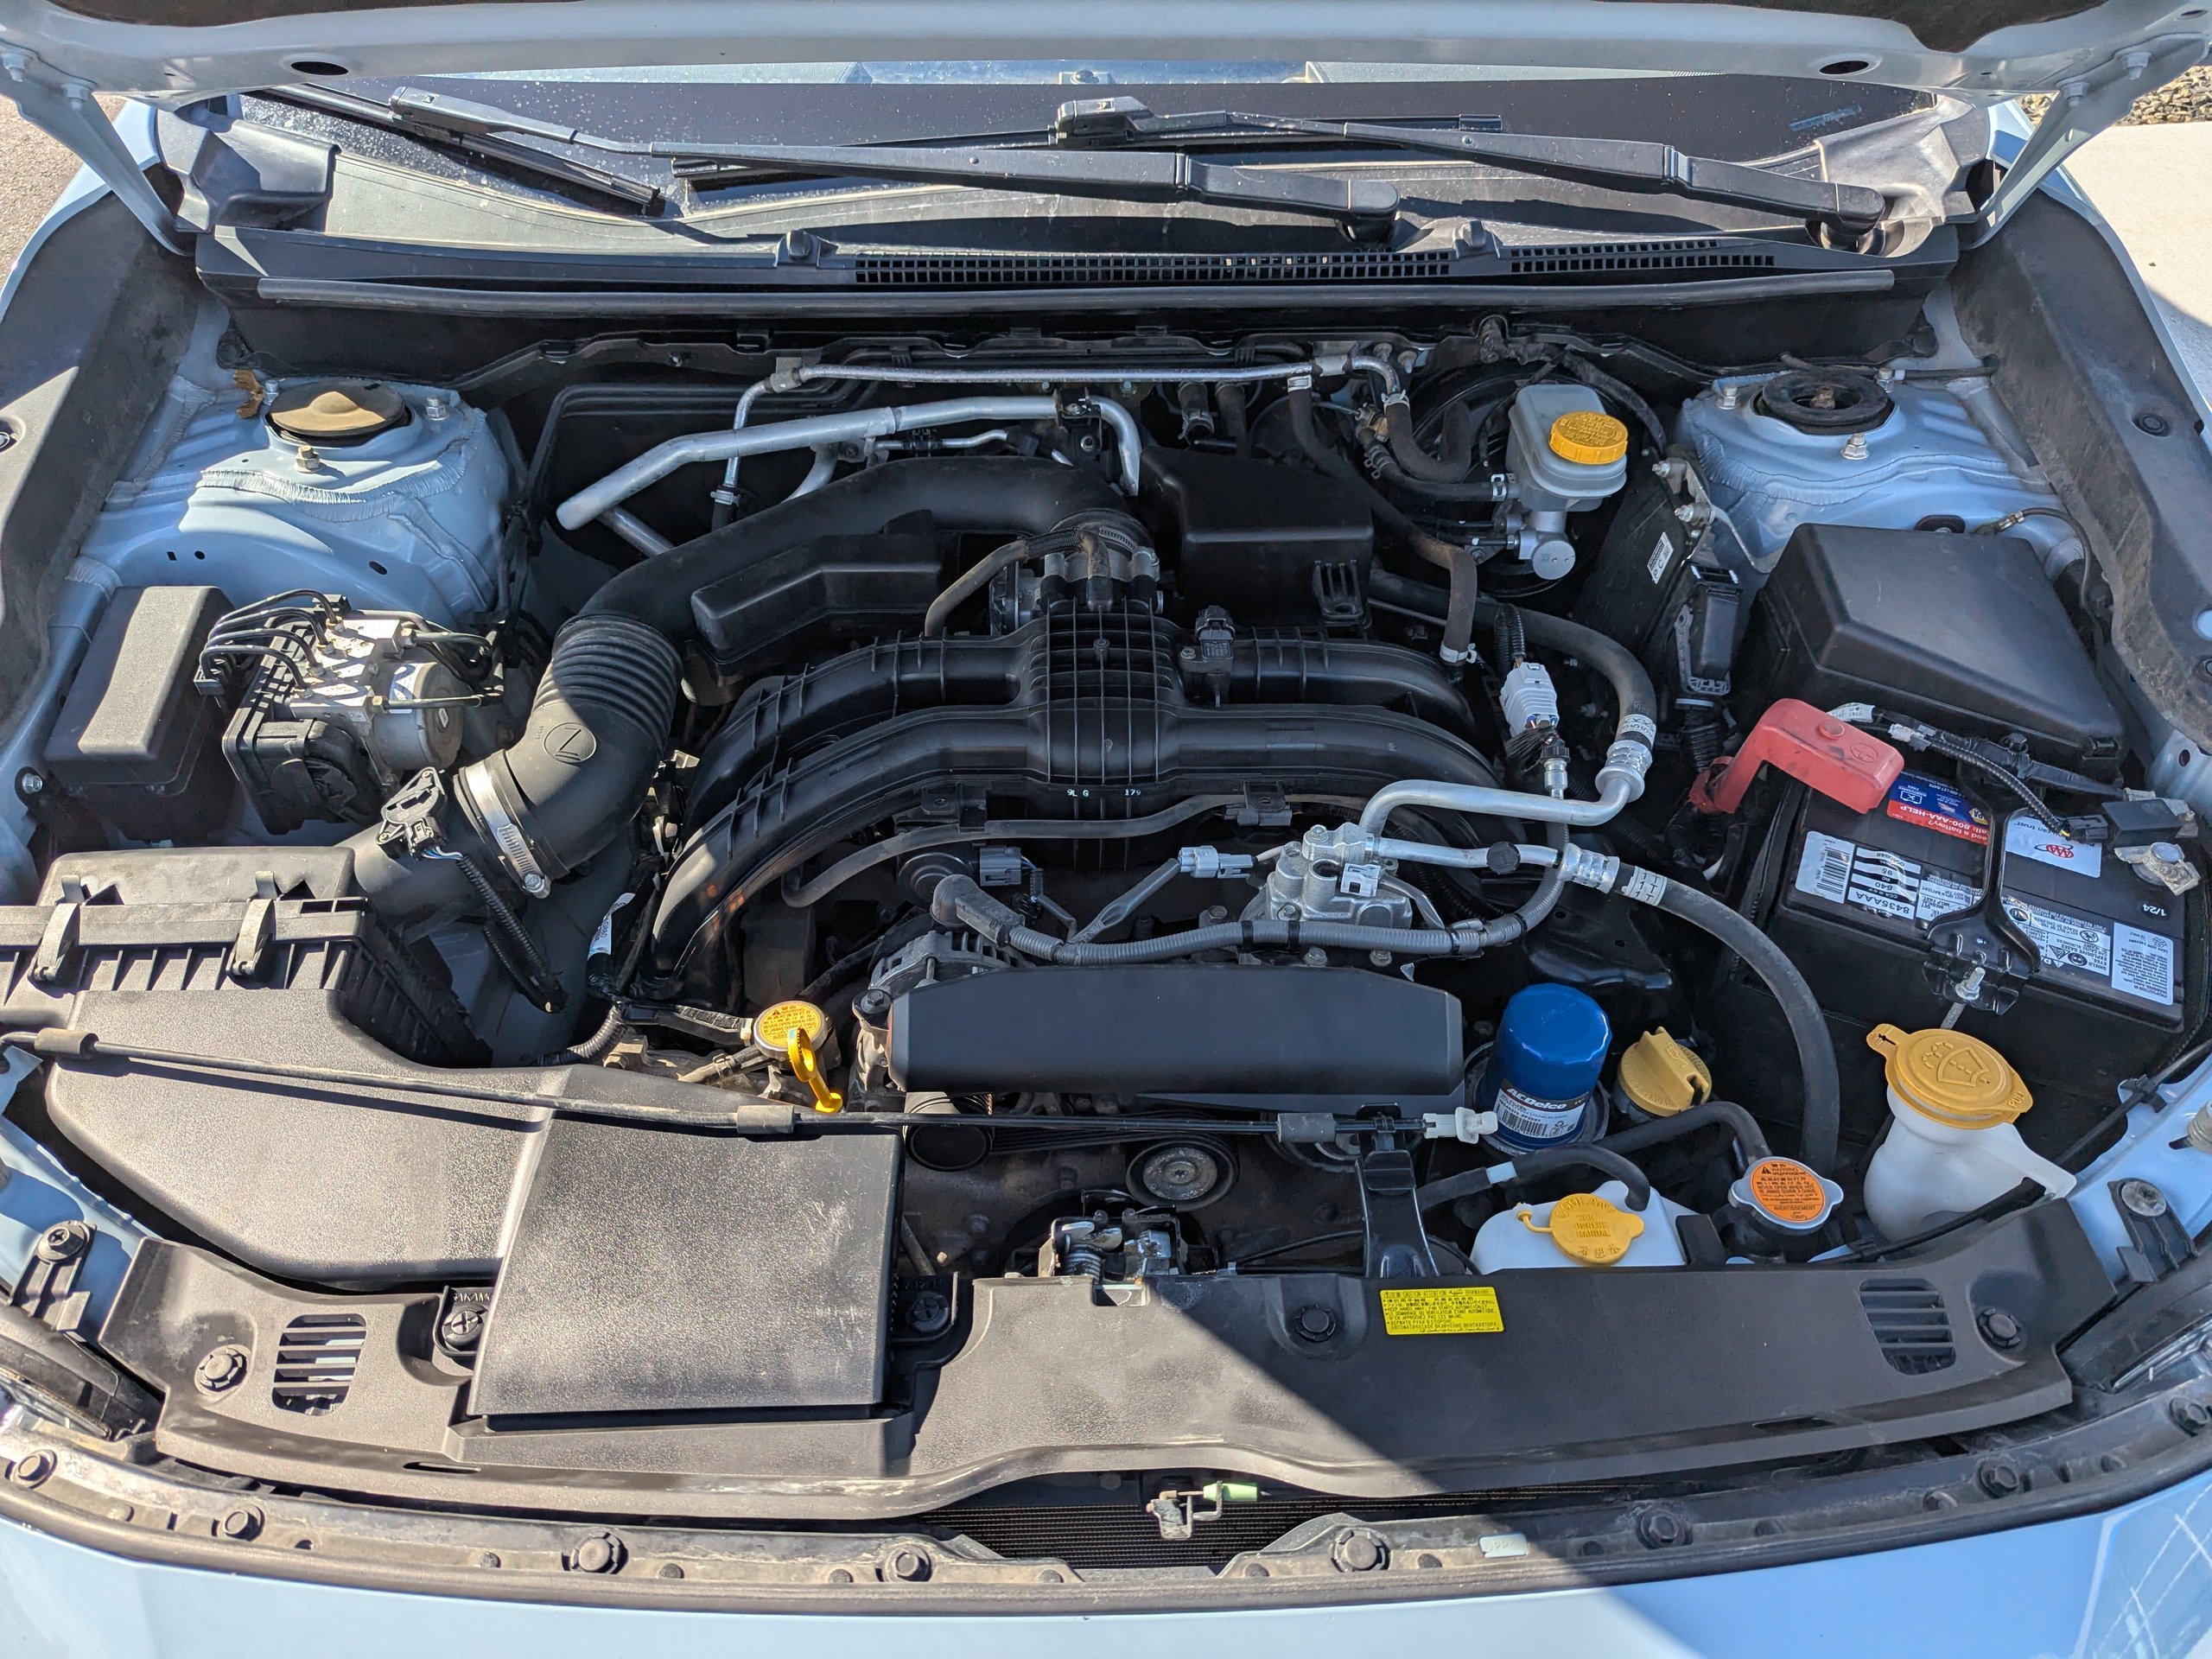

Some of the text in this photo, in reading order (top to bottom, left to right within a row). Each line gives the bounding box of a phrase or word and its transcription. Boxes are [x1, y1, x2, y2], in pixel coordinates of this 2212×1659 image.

[1899, 804, 1970, 830] 800-AAA-HELP
[1928, 815, 1962, 834] battery?
[1881, 867, 1892, 876] 95
[1649, 883, 1658, 893] T
[1874, 880, 1892, 891] 640
[1854, 891, 1910, 914] 8435AAA
[2143, 904, 2166, 916] 1/24
[1507, 1089, 1567, 1109] ACDelco
[2007, 1090, 2026, 1109] PULL
[1556, 1196, 1618, 1219] COOLANT
